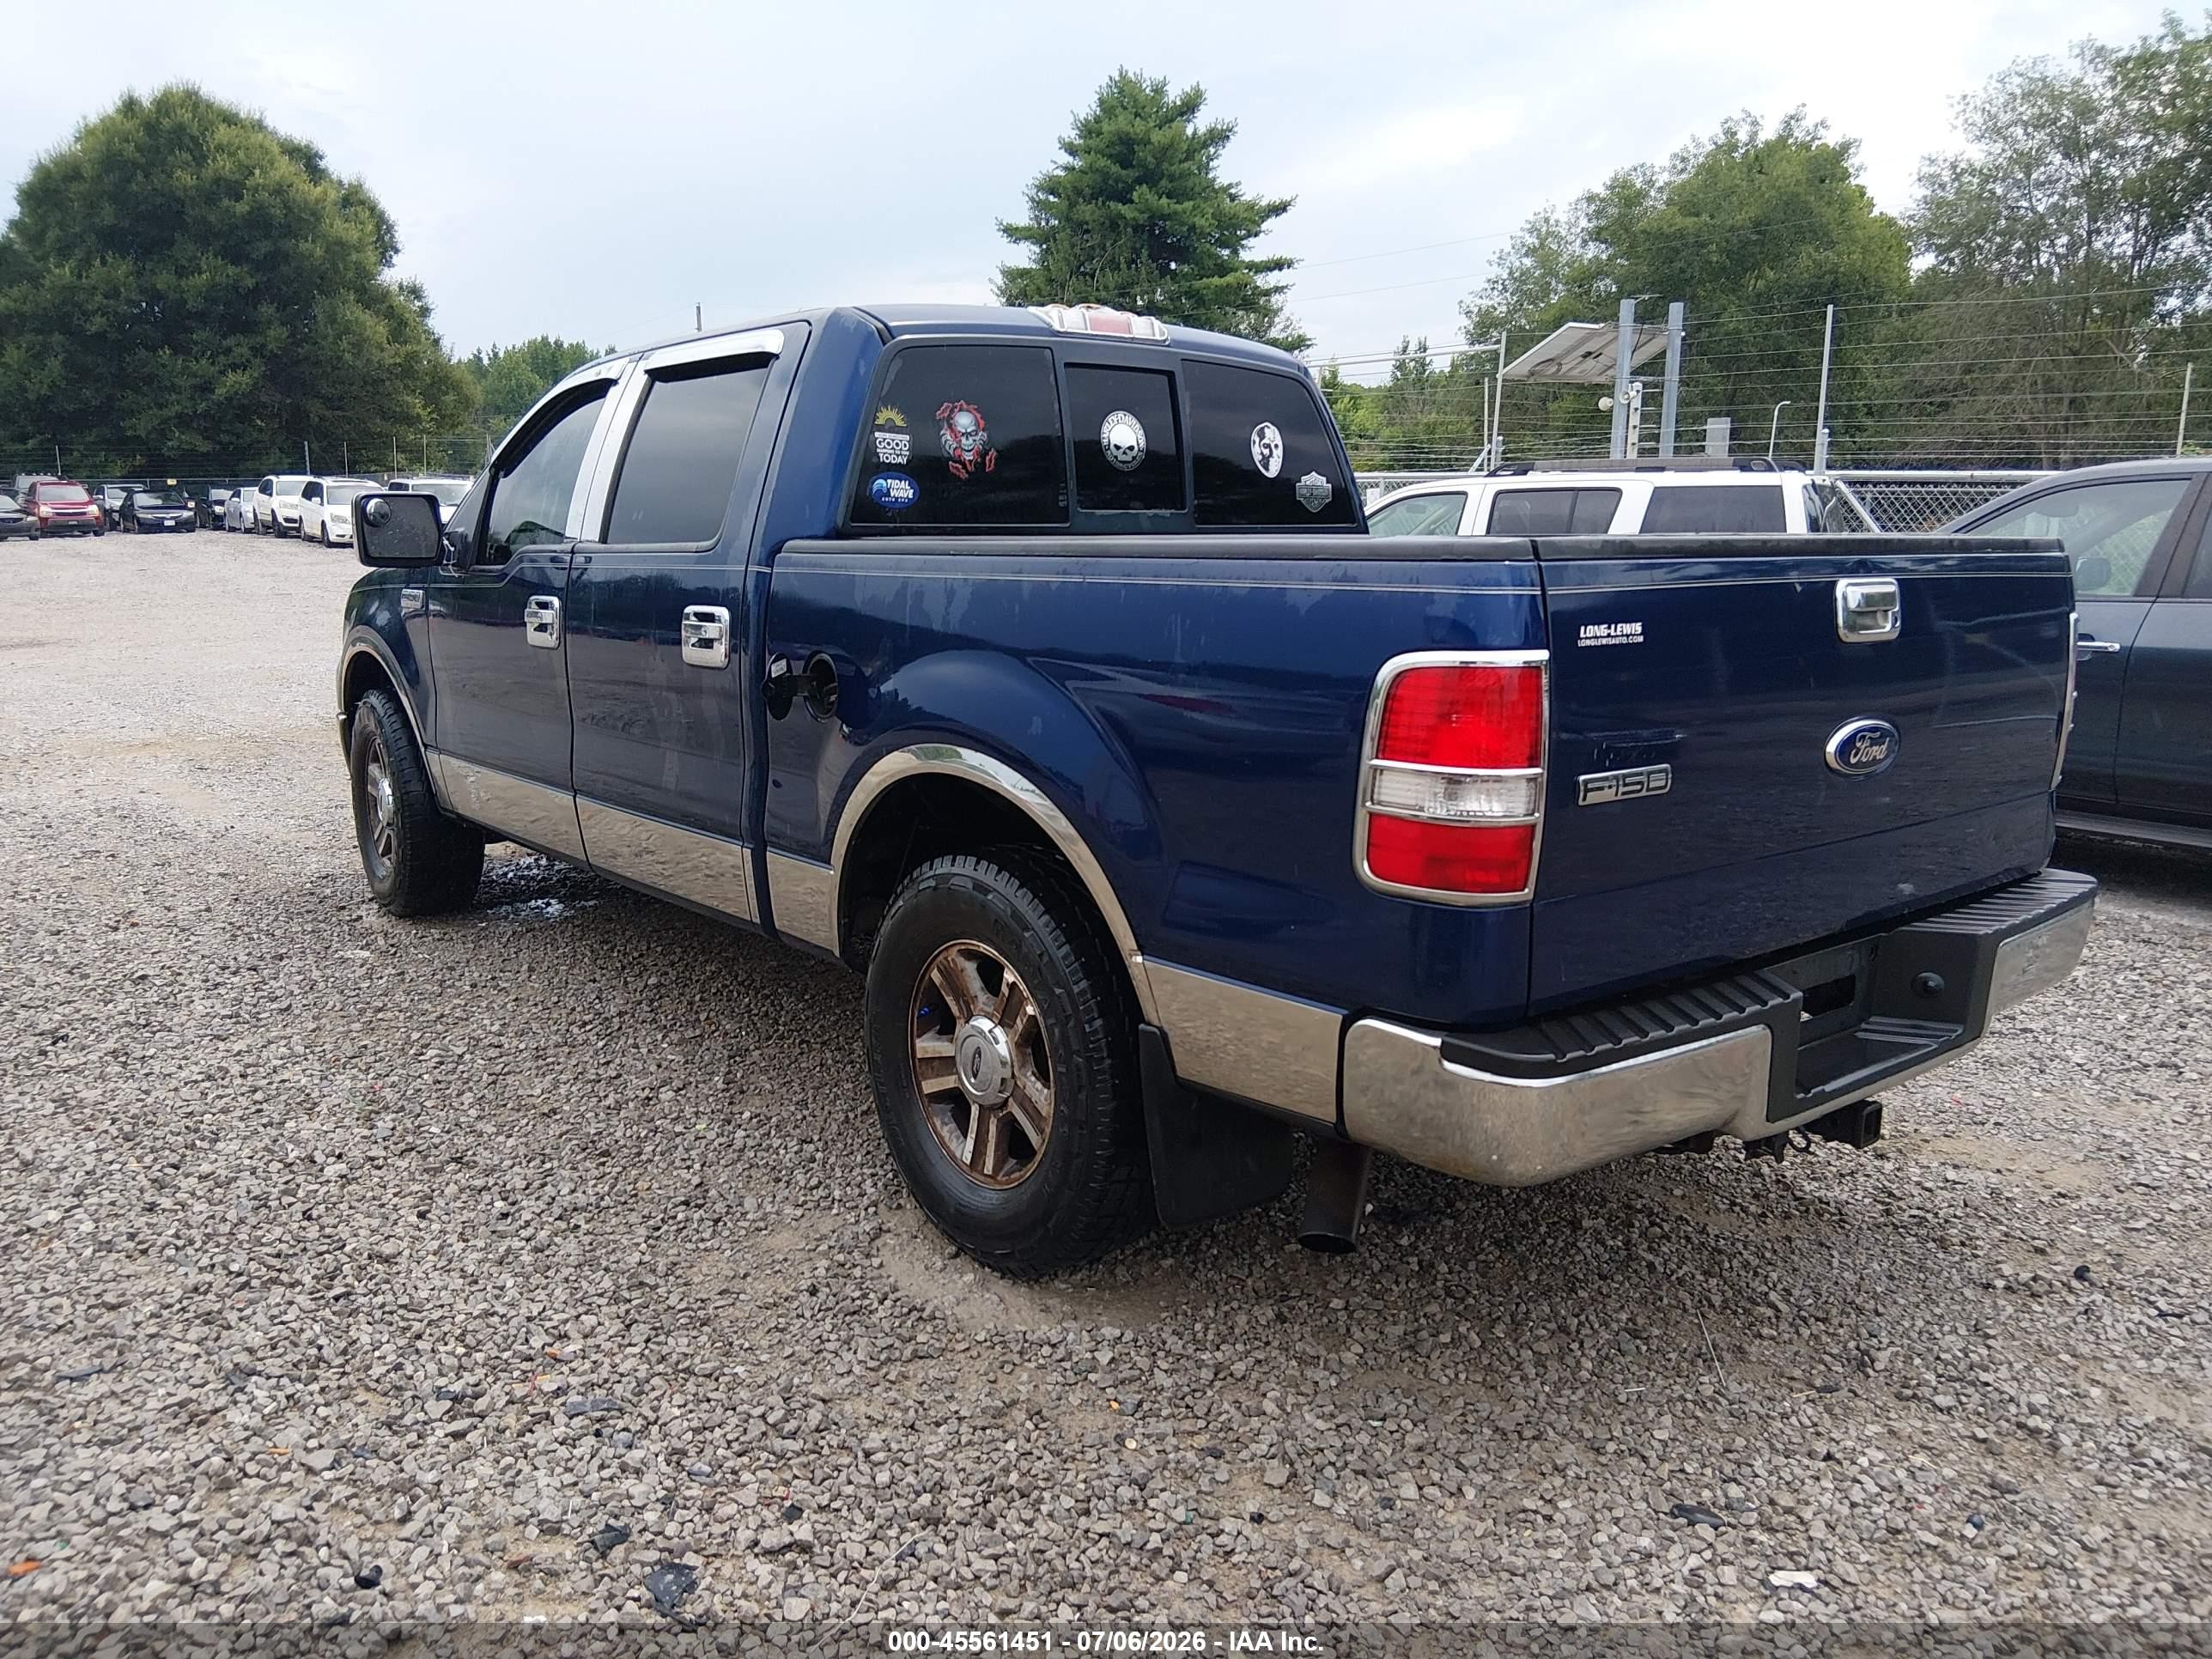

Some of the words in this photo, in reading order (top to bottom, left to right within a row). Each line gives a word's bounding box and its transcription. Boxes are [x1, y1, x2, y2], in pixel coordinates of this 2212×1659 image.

[876, 438, 909, 451] GOOD
[878, 453, 908, 465] TODAY
[886, 478, 910, 489] TIDAL
[890, 488, 915, 499] WAVE
[1579, 622, 1643, 638] LONG-LEWIS
[1577, 635, 1644, 647] LONGLEWISAUTO.COM
[1849, 731, 1892, 765] Ford
